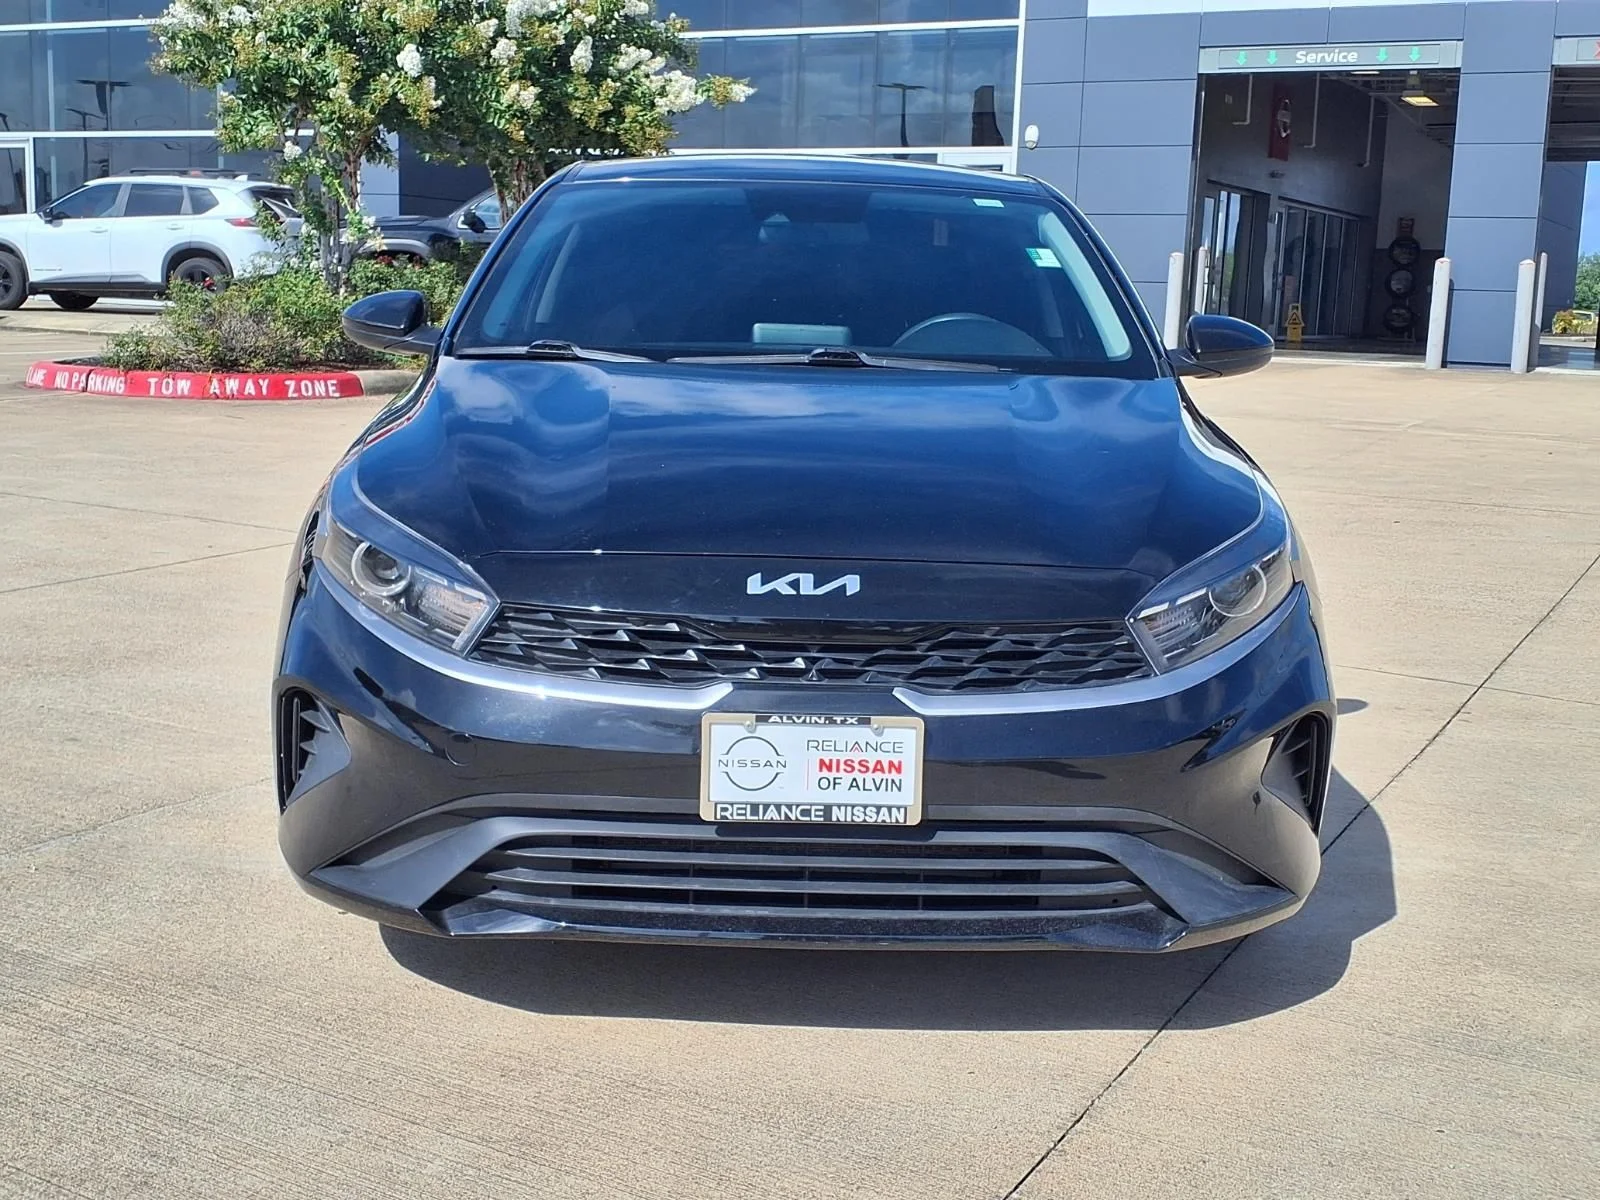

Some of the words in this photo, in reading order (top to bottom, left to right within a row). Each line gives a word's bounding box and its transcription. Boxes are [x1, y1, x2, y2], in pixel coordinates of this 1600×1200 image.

[1295, 48, 1358, 64] Service
[54, 371, 69, 389] NO
[72, 372, 125, 394] PARKING
[147, 377, 191, 396] TOW
[208, 378, 270, 396] AWAY
[284, 380, 340, 397] ZONE
[746, 572, 861, 596] KIA
[833, 716, 858, 725] TX
[807, 740, 904, 753] RELIANCE
[718, 759, 787, 768] NISSAN
[818, 758, 902, 774] NISSAN
[817, 777, 843, 790] OF
[848, 778, 902, 792] ALVIN
[716, 805, 824, 821] RELIANCE
[831, 806, 905, 823] NISSAN
